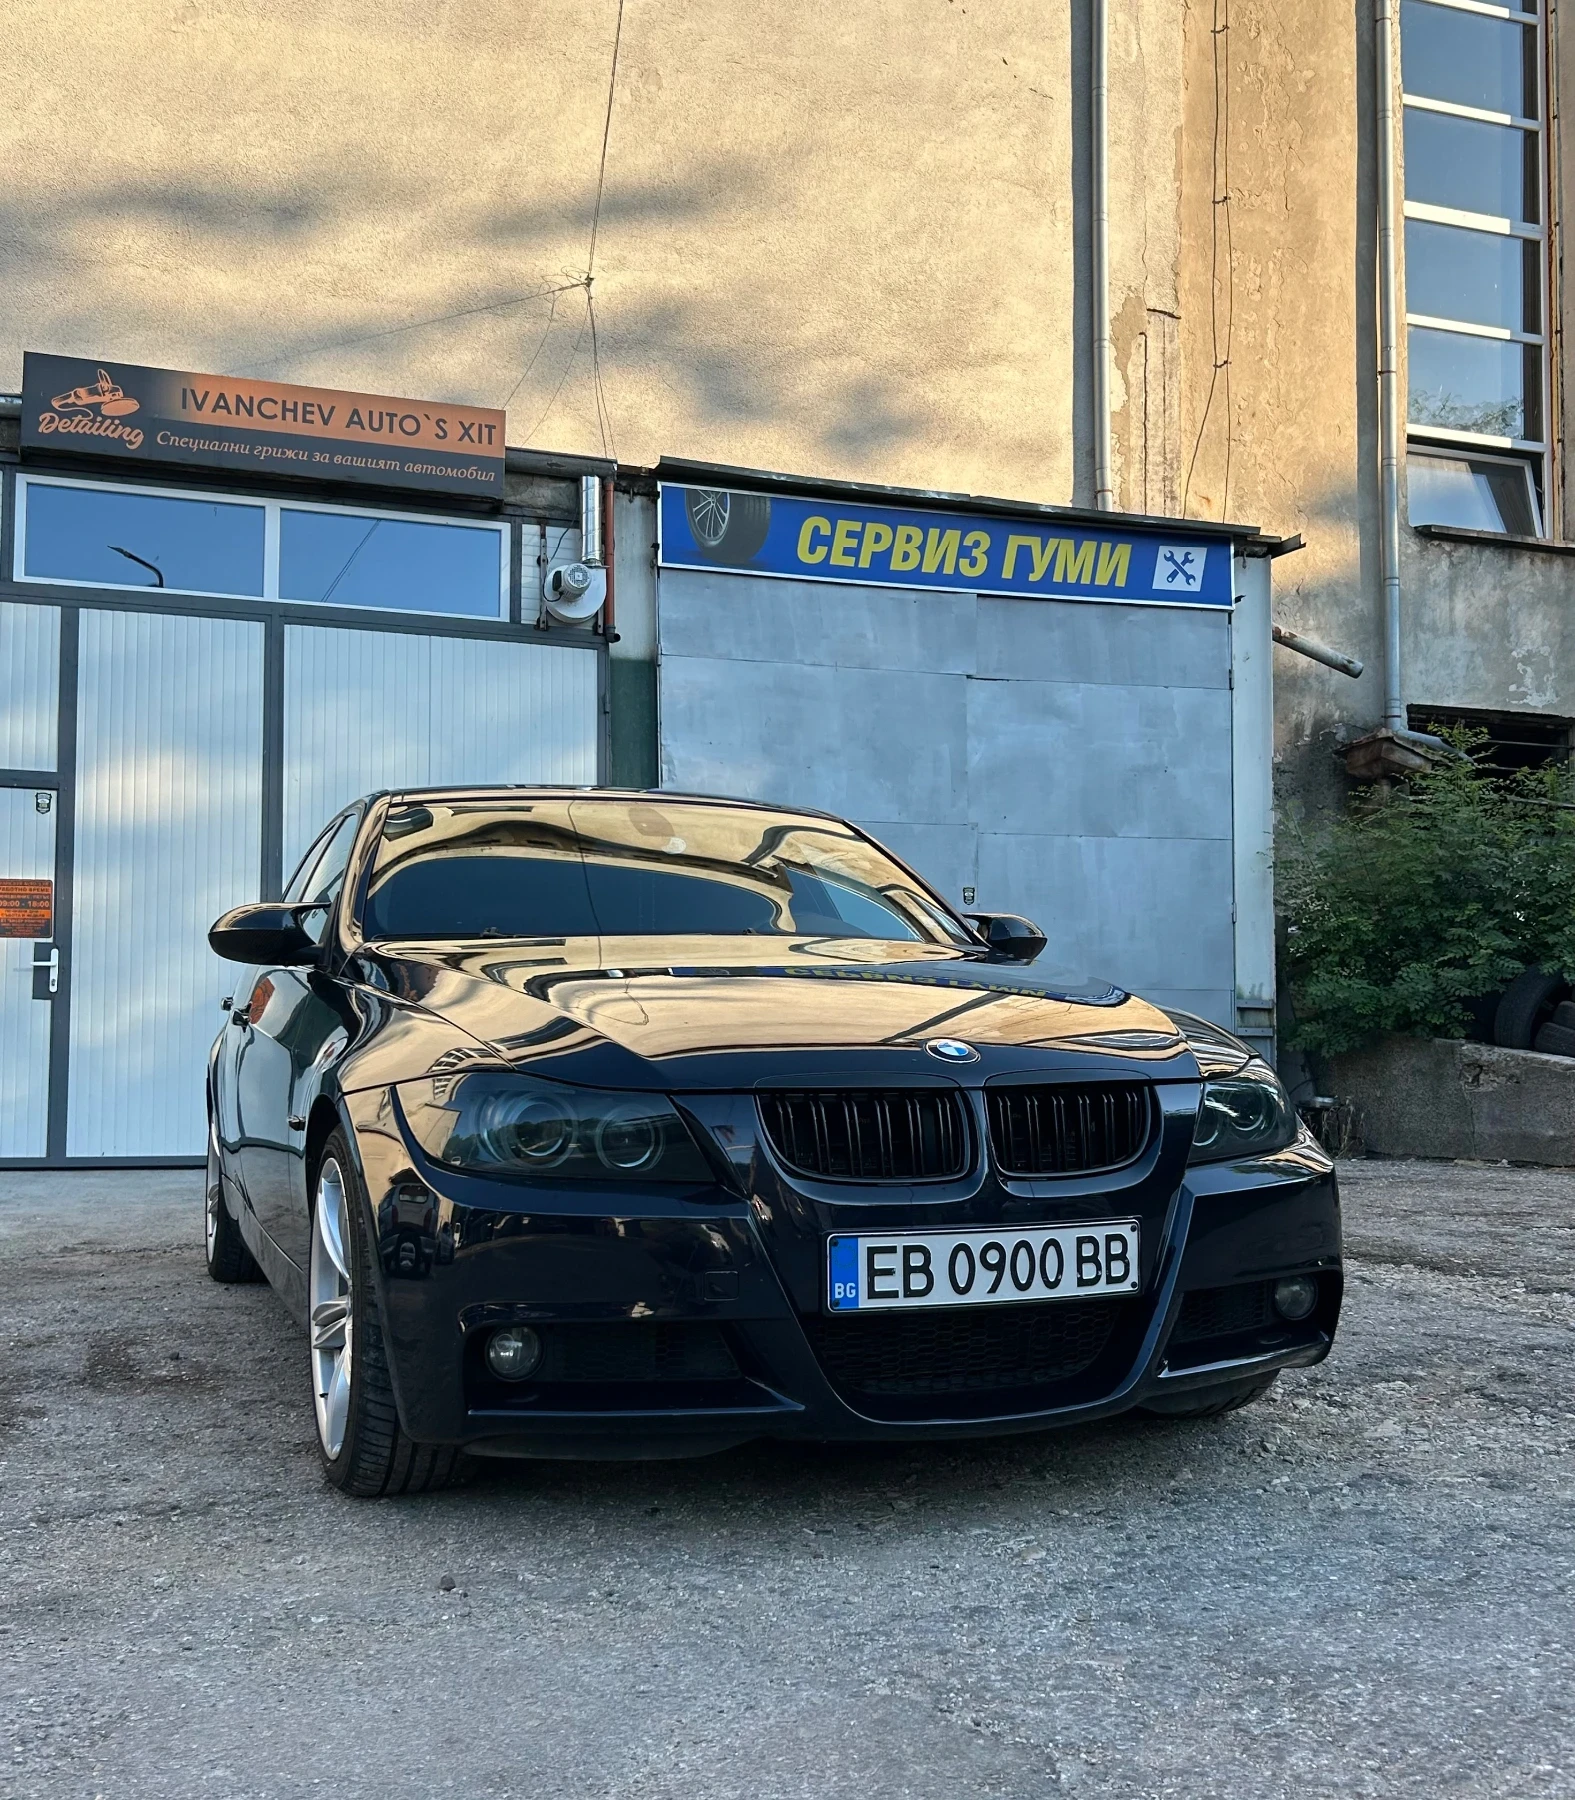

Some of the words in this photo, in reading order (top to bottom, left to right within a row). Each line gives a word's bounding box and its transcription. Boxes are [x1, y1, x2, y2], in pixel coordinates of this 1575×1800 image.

[38, 412, 145, 450] Detailing
[181, 388, 336, 426] IVANCHEV
[458, 421, 497, 445] XIT
[156, 431, 250, 454] Специални
[253, 443, 308, 460] грижи
[312, 451, 330, 464] за
[334, 454, 400, 471] вашият
[404, 462, 496, 482] автомобил
[797, 515, 991, 578] СЕРВИЗ
[1001, 534, 1133, 588] ГУМИ
[834, 1282, 857, 1299] BG
[866, 1244, 934, 1300] EB
[948, 1237, 1064, 1296] 0900
[1076, 1232, 1131, 1288] BB
